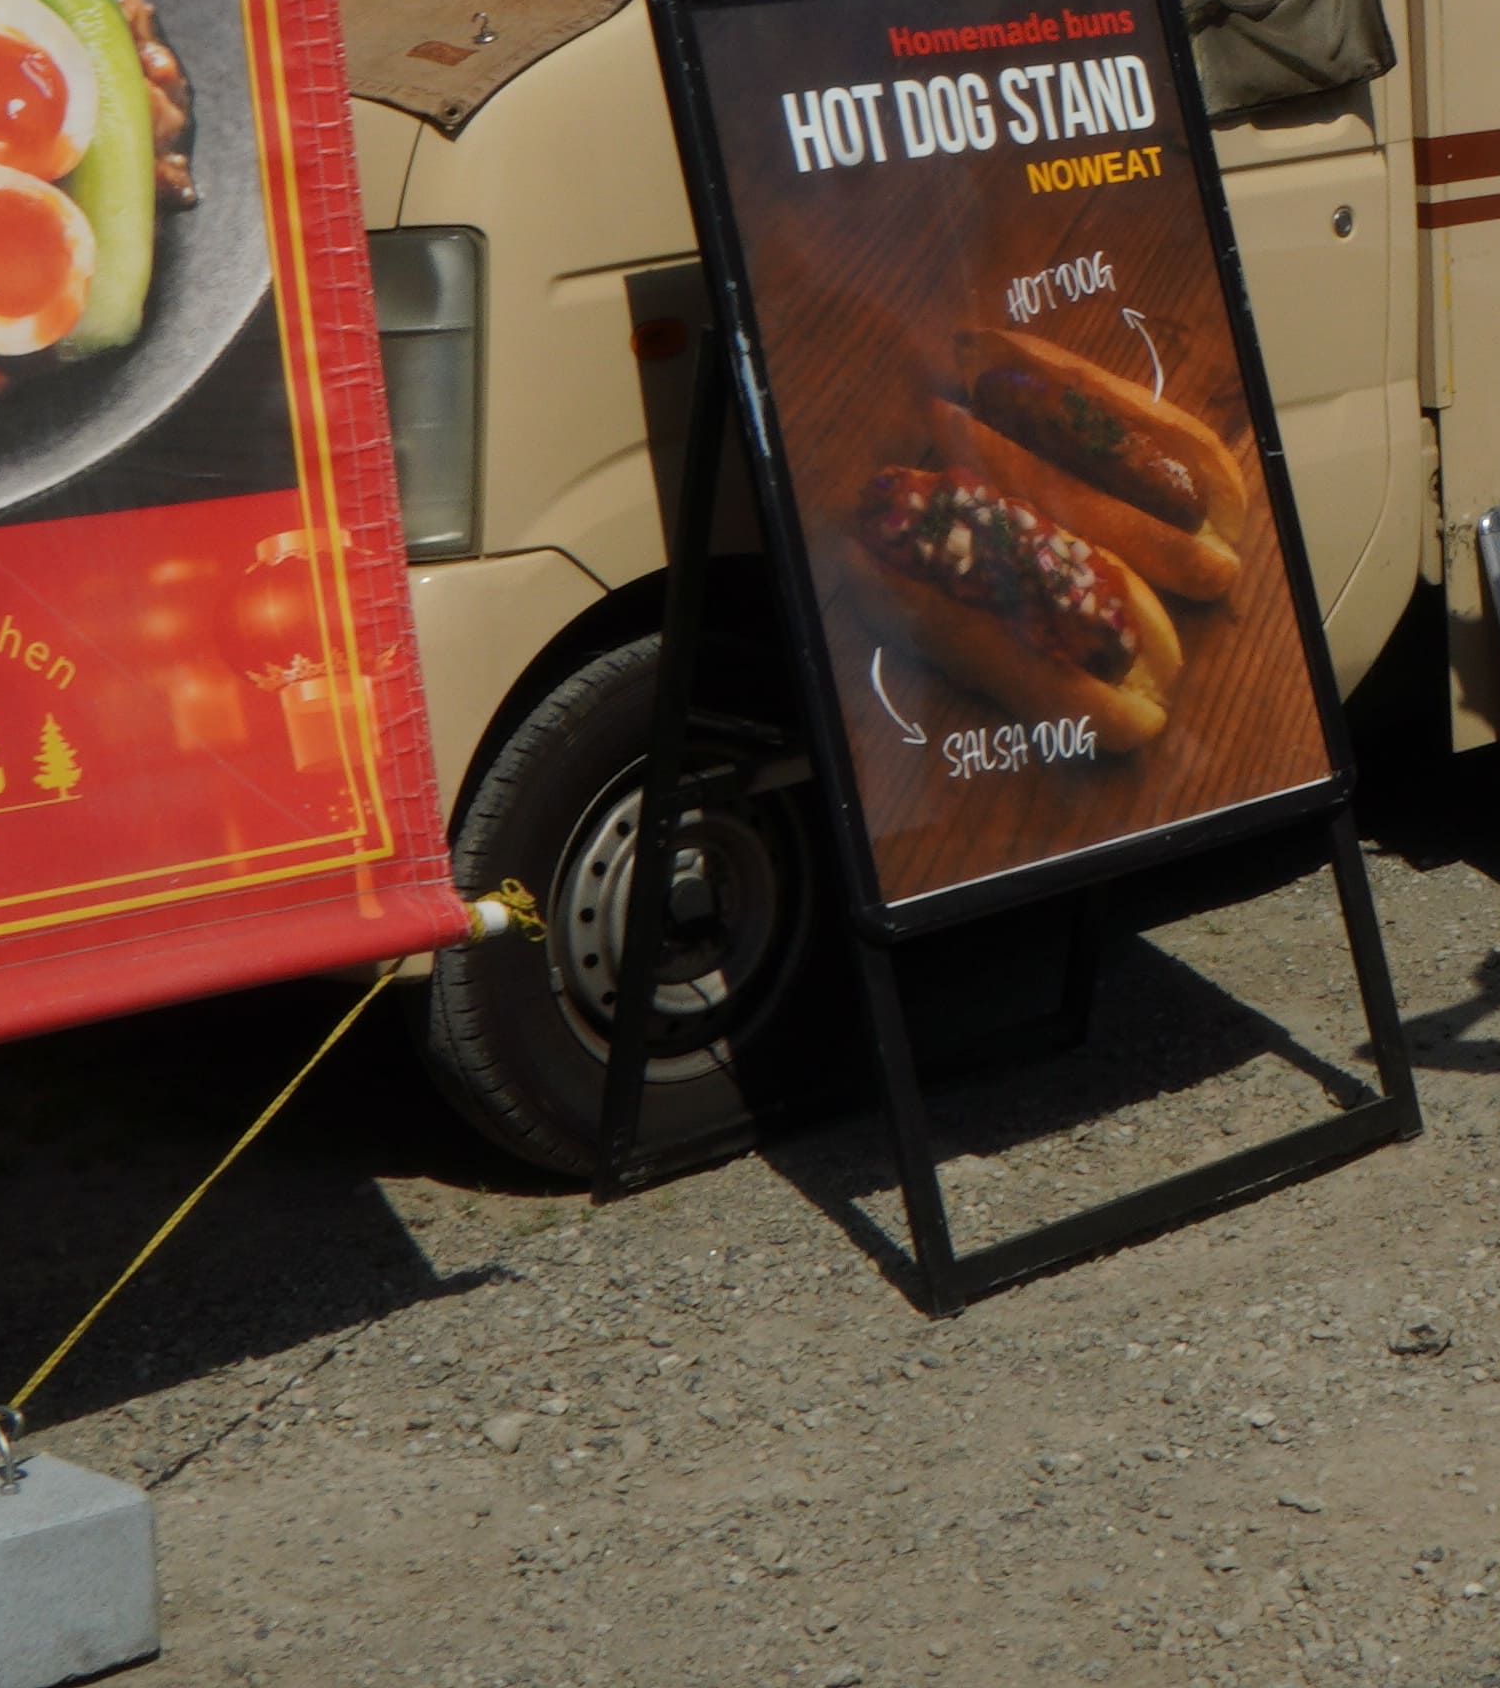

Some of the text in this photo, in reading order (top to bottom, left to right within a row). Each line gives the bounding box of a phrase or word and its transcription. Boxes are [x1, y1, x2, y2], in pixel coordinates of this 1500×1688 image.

[887, 7, 1136, 58] Homemade buns
[781, 54, 1156, 174] HOT DOG STAND
[1025, 145, 1164, 195] NOWEAT
[1006, 250, 1117, 323] HOT DOG
[942, 715, 1098, 779] SALSA DOG
